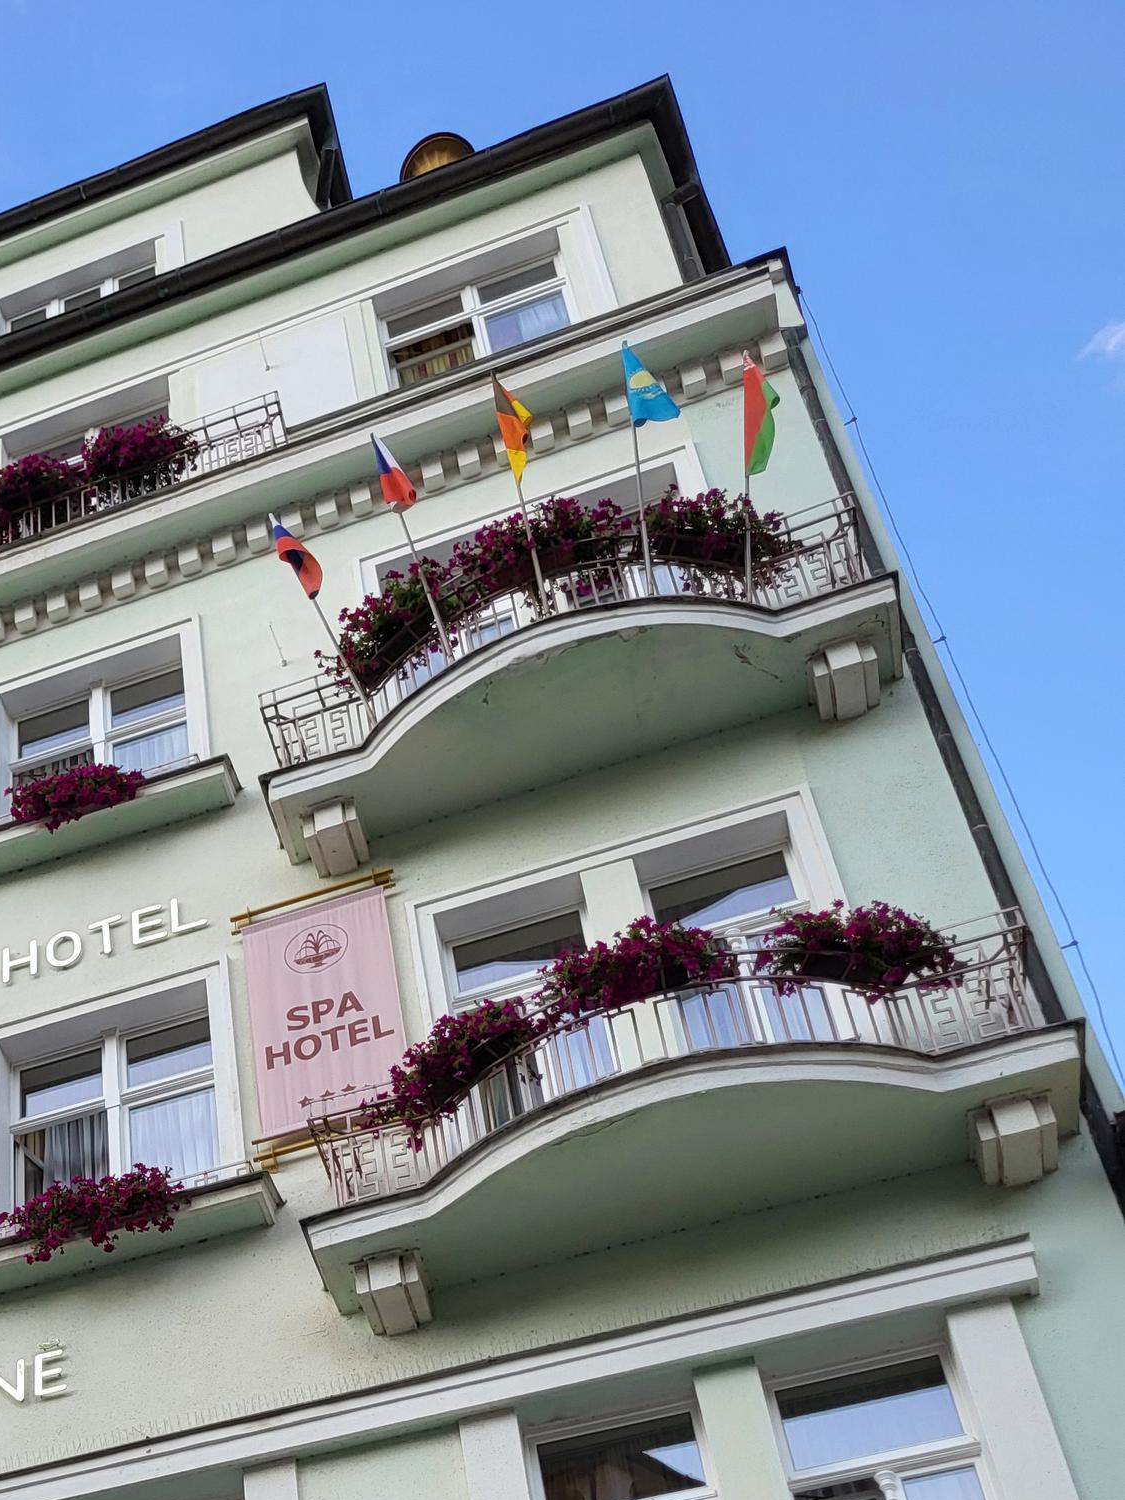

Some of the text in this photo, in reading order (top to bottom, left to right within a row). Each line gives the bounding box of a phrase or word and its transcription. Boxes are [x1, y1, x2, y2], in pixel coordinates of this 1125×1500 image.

[1, 897, 210, 985] HOTEL
[285, 990, 365, 1032] SPA
[264, 1014, 396, 1071] HOTEL
